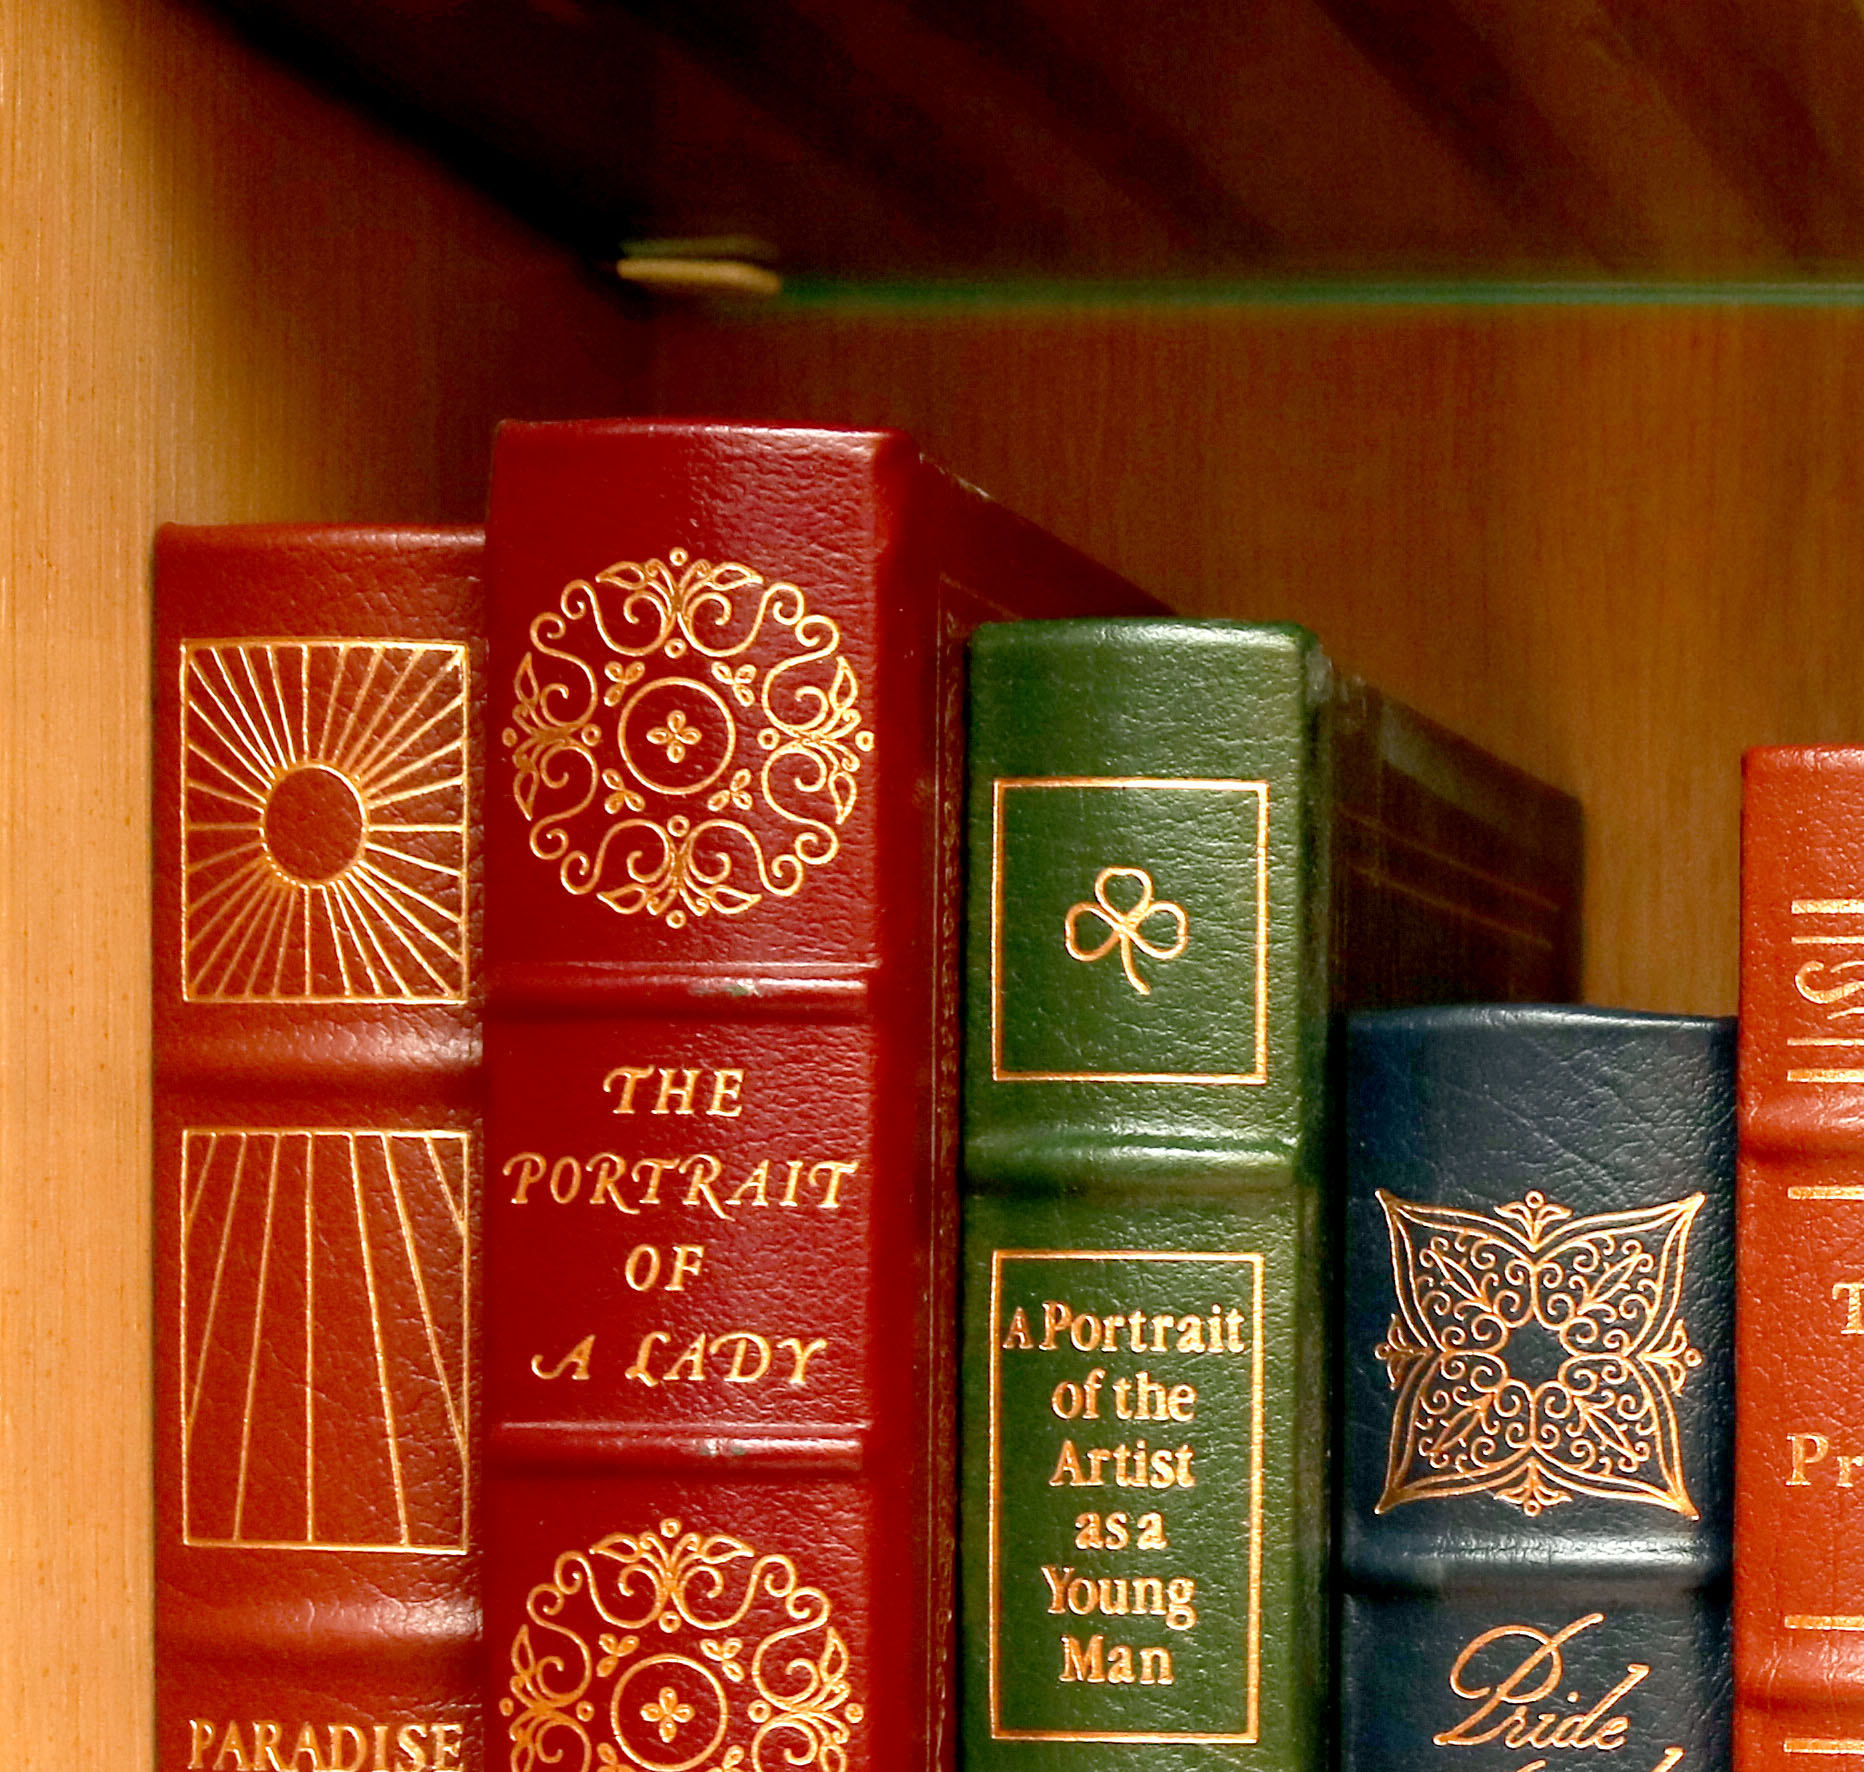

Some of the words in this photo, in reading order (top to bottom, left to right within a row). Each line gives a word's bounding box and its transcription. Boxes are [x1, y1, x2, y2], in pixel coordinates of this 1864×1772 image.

[602, 1066, 744, 1117] THE
[501, 1154, 859, 1211] PORTRAIT
[624, 1245, 705, 1292] OF
[1003, 1308, 1033, 1350] A
[1039, 1303, 1245, 1355] Portrait
[531, 1335, 592, 1382] A
[625, 1337, 827, 1388] LADY
[1052, 1369, 1103, 1420] of
[1106, 1372, 1196, 1422] the
[1050, 1441, 1194, 1489] Artist
[1075, 1511, 1133, 1549] as
[1138, 1511, 1168, 1550] a
[1042, 1566, 1195, 1630] Young
[1059, 1636, 1174, 1686] Man
[1433, 1612, 1650, 1750] Pride
